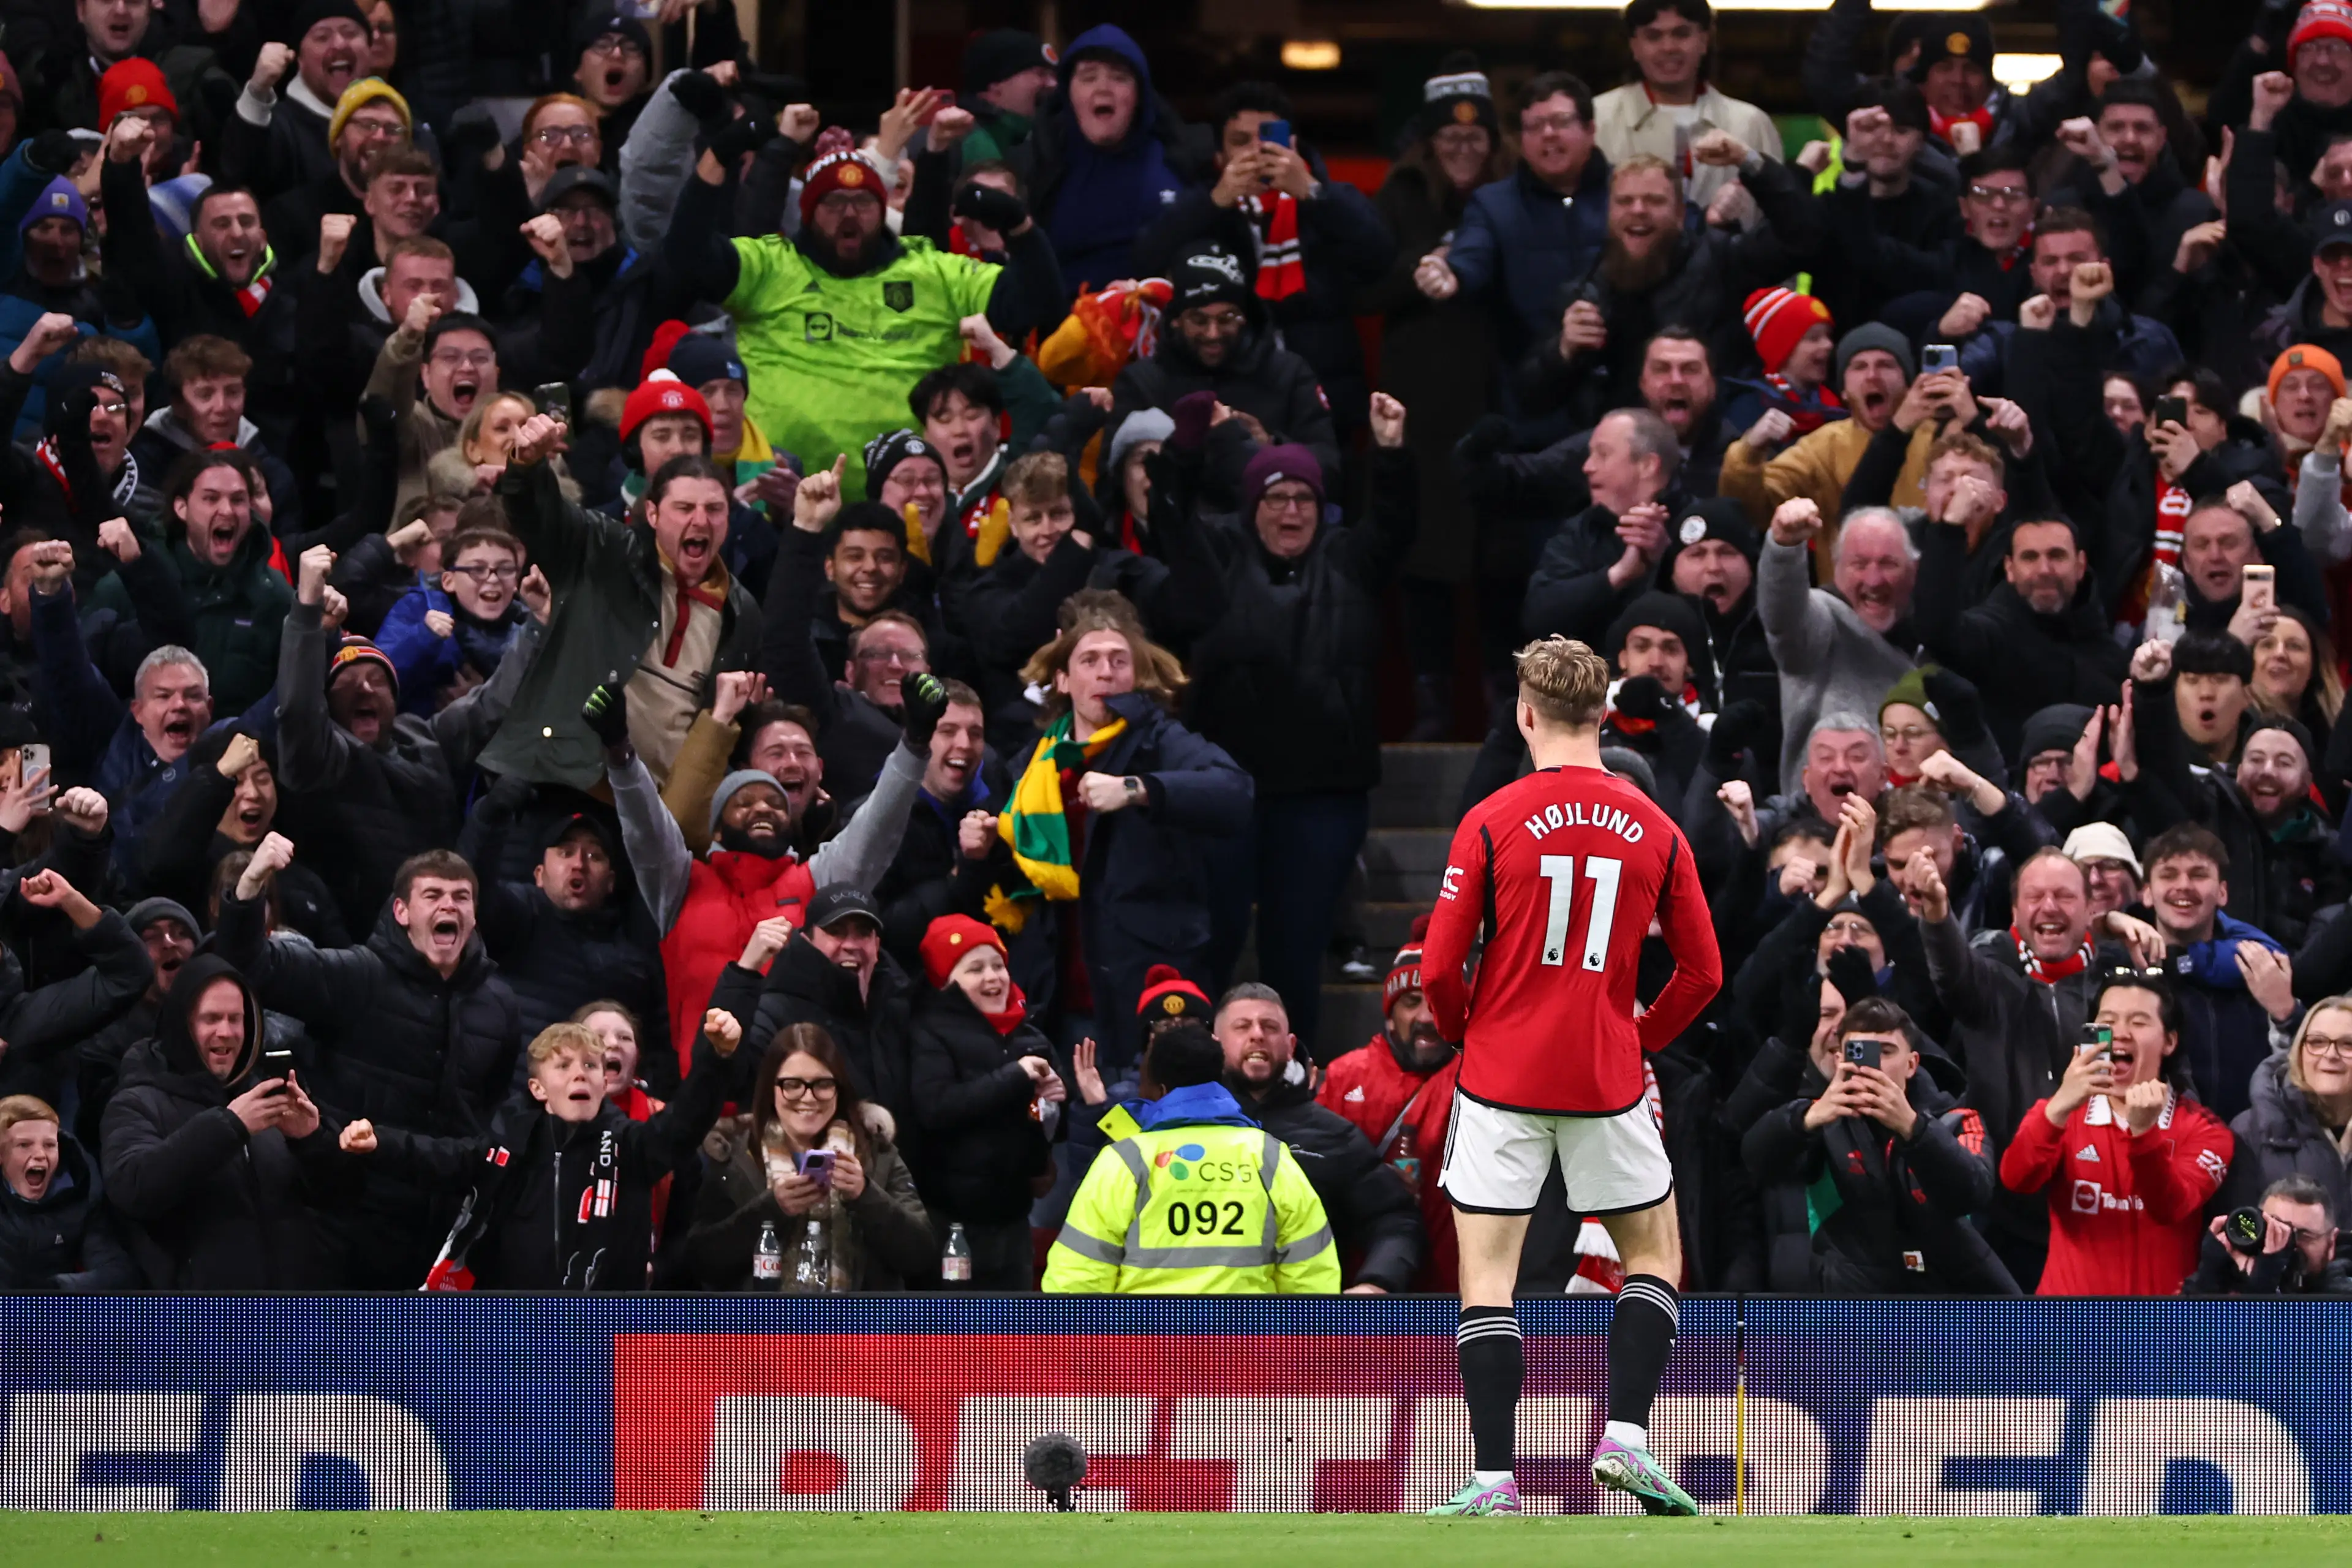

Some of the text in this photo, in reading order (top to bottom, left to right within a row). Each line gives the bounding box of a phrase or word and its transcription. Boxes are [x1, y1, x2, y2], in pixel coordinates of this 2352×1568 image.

[1524, 802, 1644, 843] HØJLUND
[1539, 854, 1623, 973] 11
[600, 1131, 612, 1167] AND
[1199, 1162, 1251, 1183] CSG
[1168, 1200, 1244, 1236] 092
